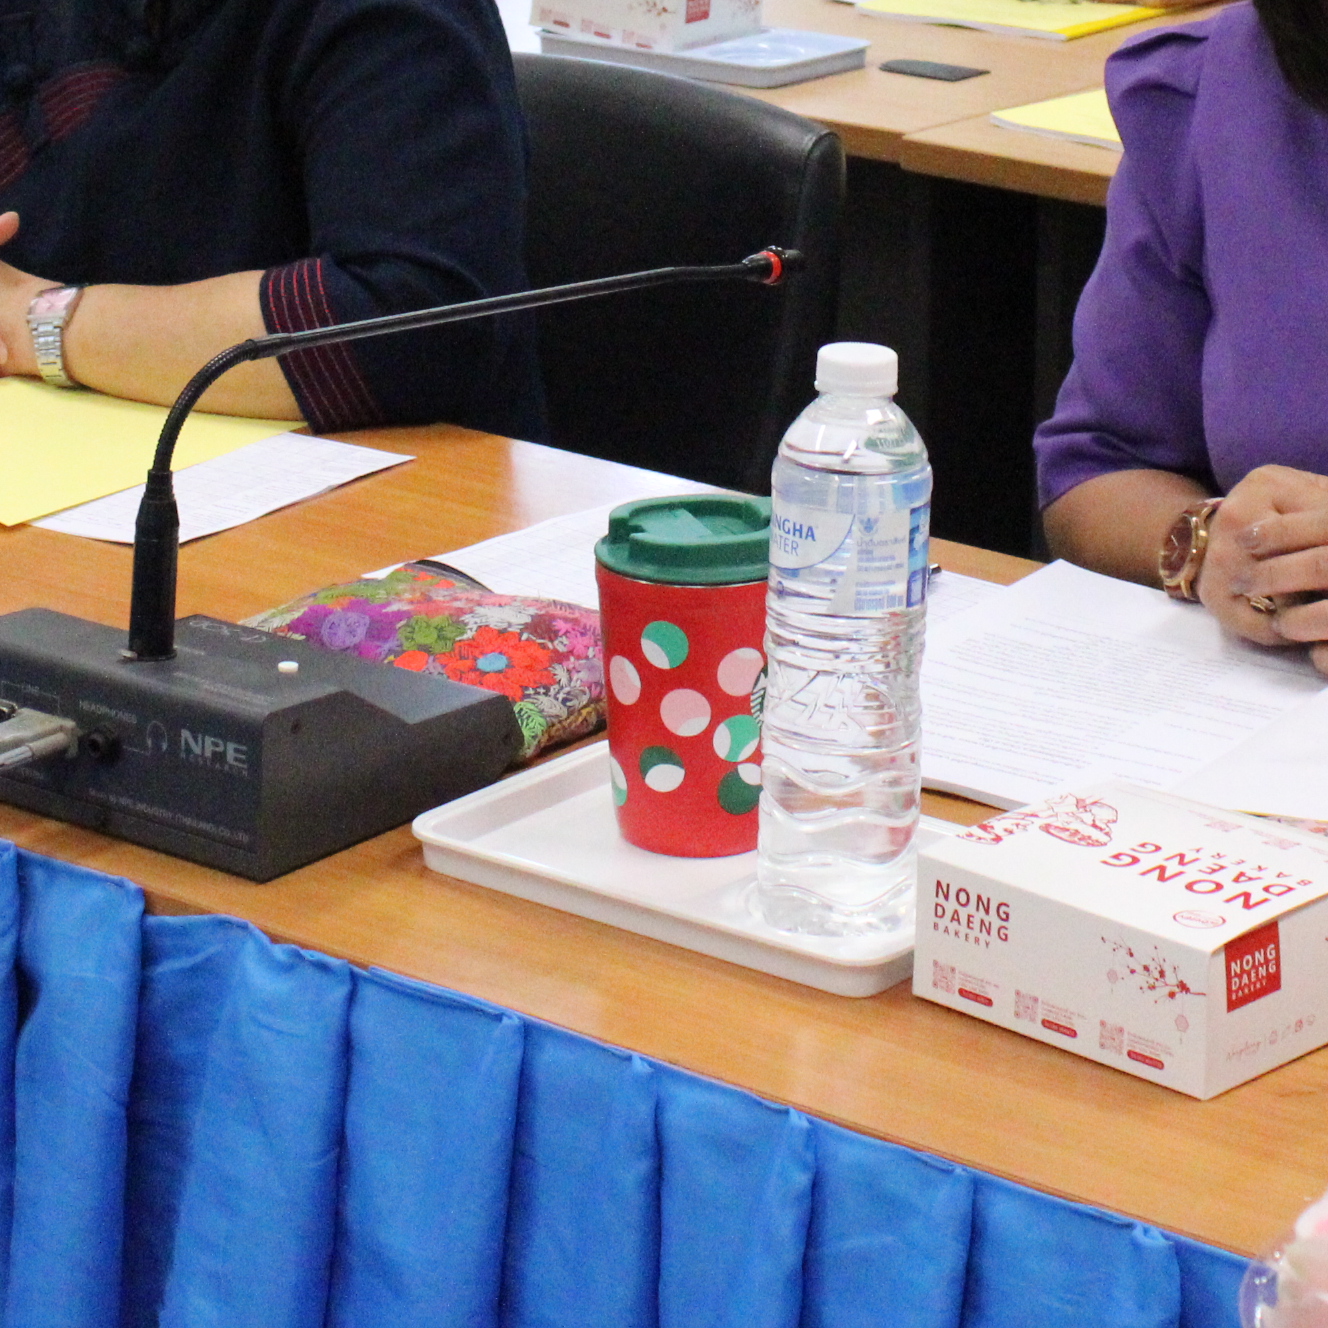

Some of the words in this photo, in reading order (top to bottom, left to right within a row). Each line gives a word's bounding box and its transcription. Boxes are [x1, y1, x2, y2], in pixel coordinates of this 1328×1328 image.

[772, 513, 816, 542] NGHA
[773, 533, 799, 557] ATER
[180, 728, 248, 769] NPE
[1100, 852, 1272, 911] NONG
[1130, 841, 1296, 898] DAENG
[1189, 846, 1313, 887] BAKERY
[935, 879, 1010, 923] NONG
[933, 921, 990, 949] BAKERY
[934, 902, 1009, 942] DAENG
[1230, 943, 1276, 977] NONG
[1231, 960, 1277, 991] DAENG
